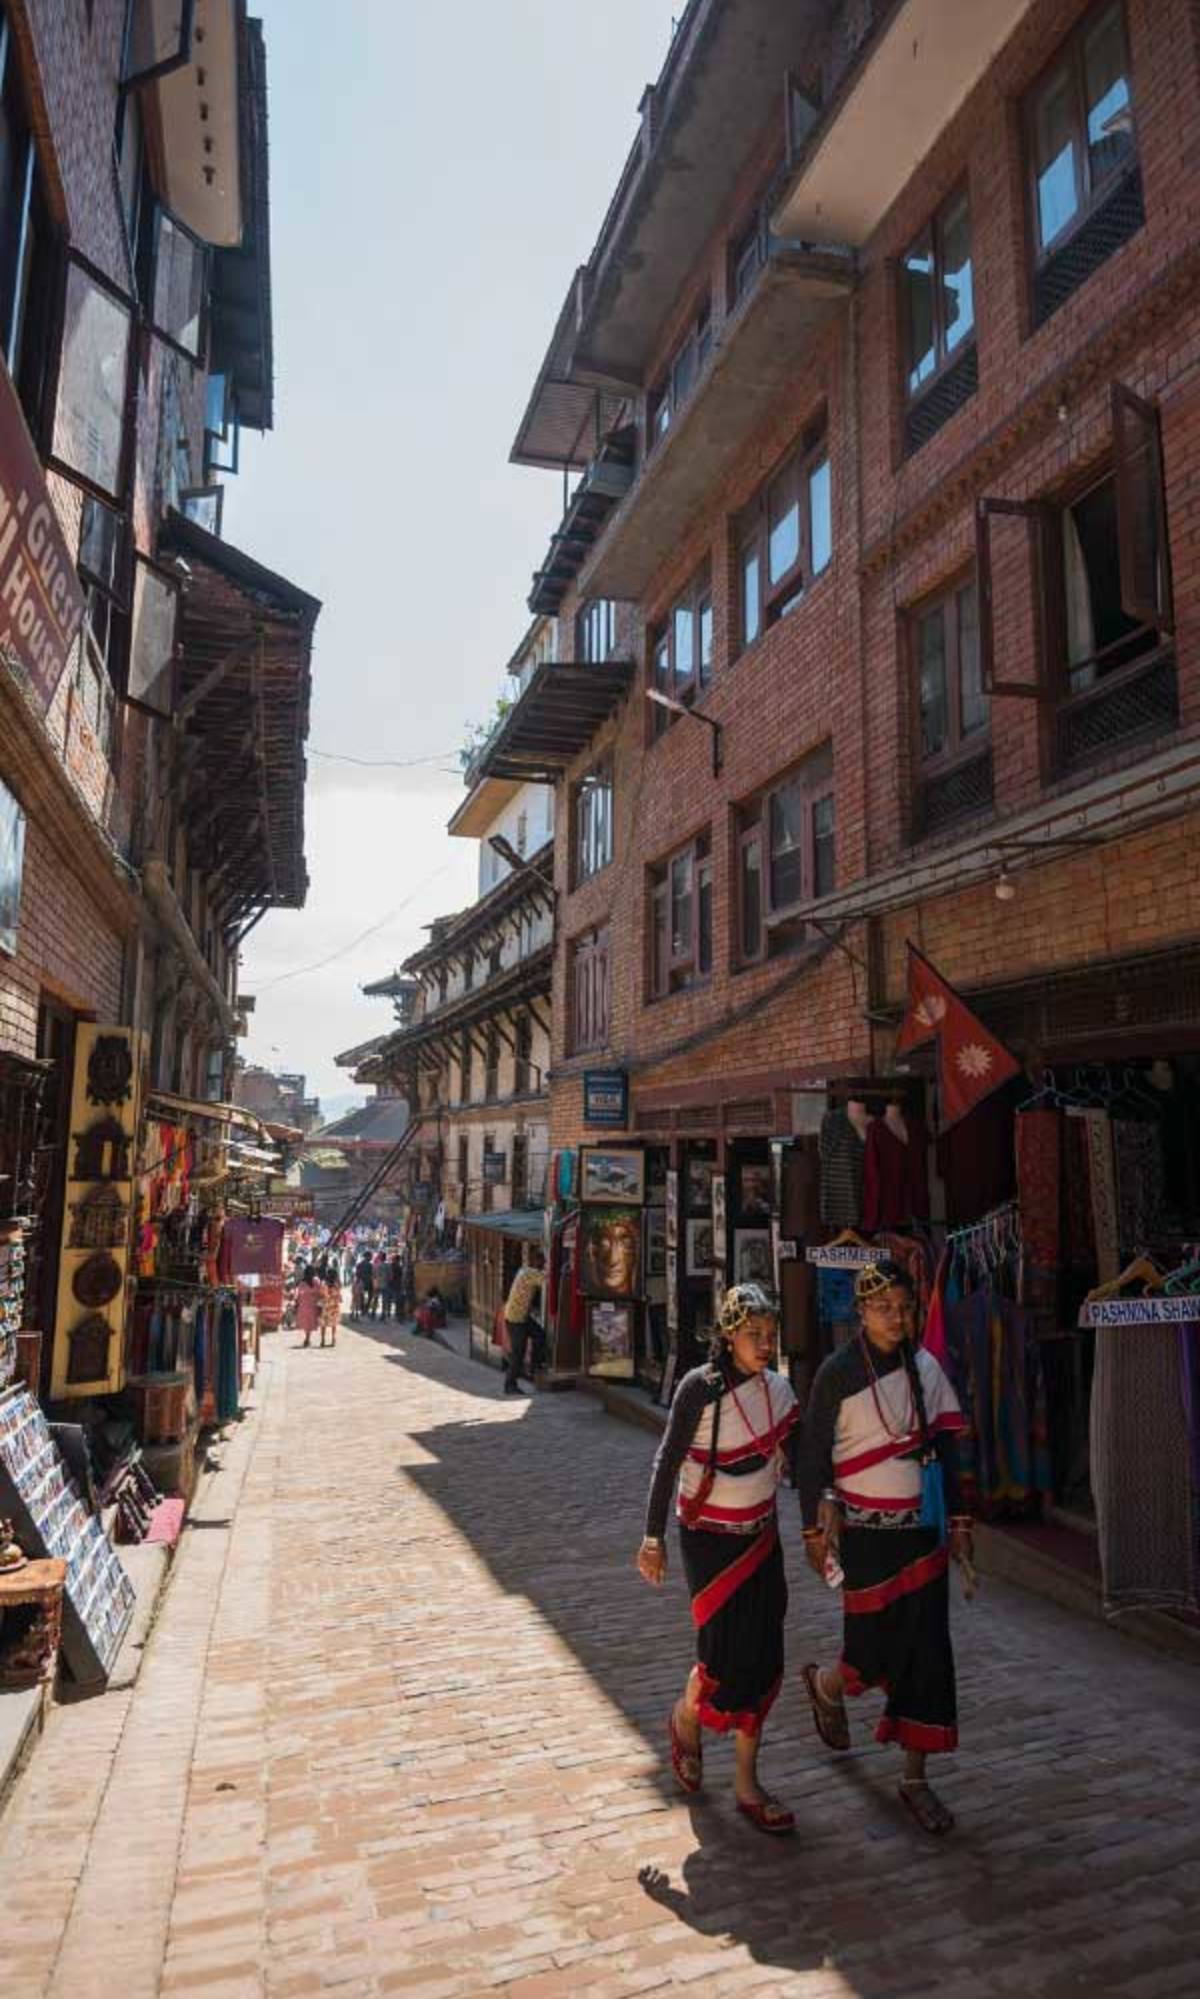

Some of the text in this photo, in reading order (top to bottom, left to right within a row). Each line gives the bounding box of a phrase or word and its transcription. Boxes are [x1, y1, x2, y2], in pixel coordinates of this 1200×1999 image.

[26, 502, 82, 644] Guest
[3, 553, 61, 690] House
[808, 1247, 889, 1262] CASHMERE
[1091, 1302, 1160, 1322] PASHMINA
